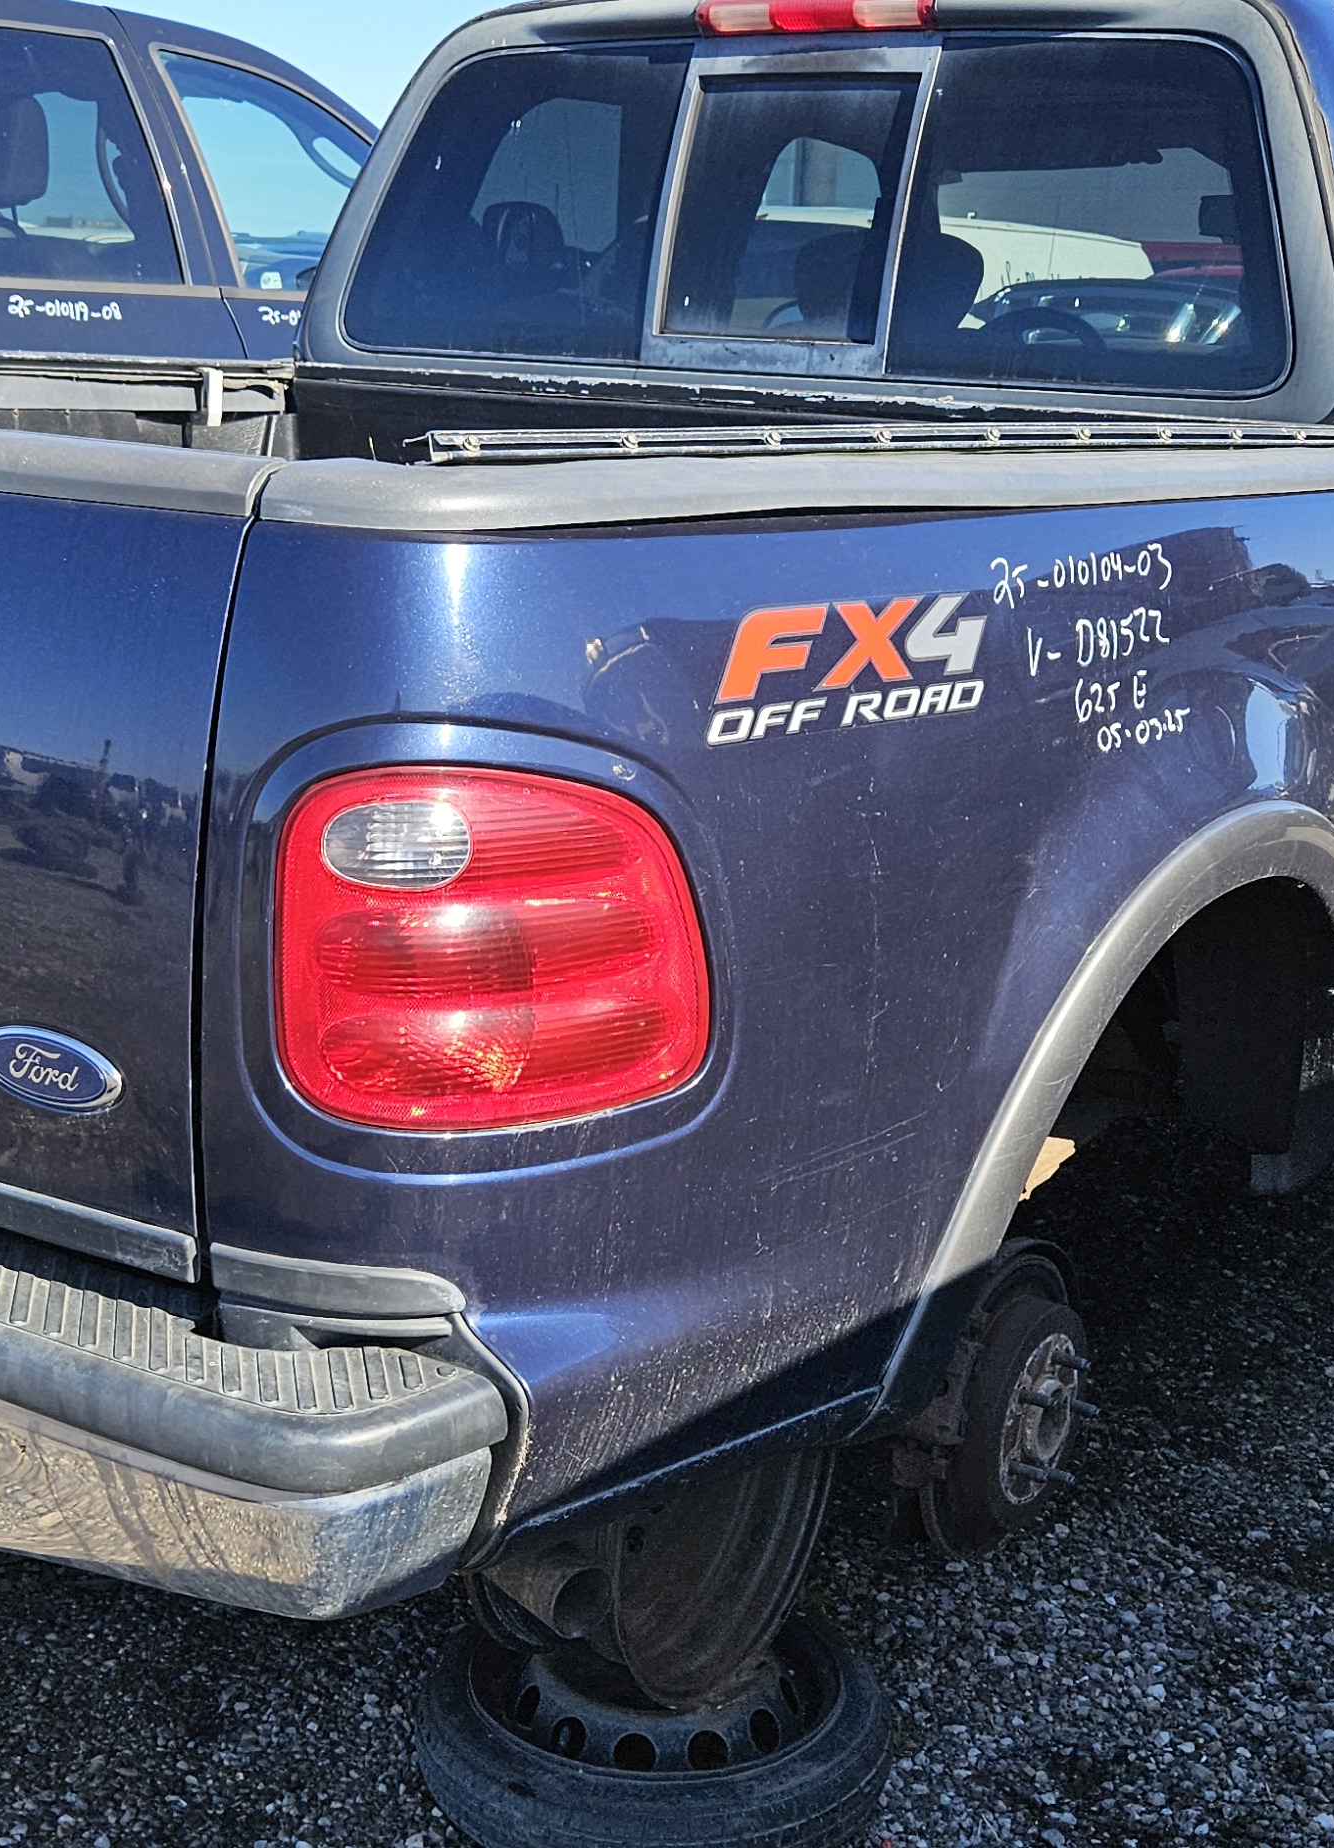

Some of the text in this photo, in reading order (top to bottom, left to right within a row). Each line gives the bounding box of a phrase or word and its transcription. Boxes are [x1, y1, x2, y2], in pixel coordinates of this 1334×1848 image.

[714, 591, 988, 704] FX4
[705, 679, 985, 747] OFF ROAD
[1074, 677, 1121, 723] 625
[9, 1043, 80, 1092] Ford
